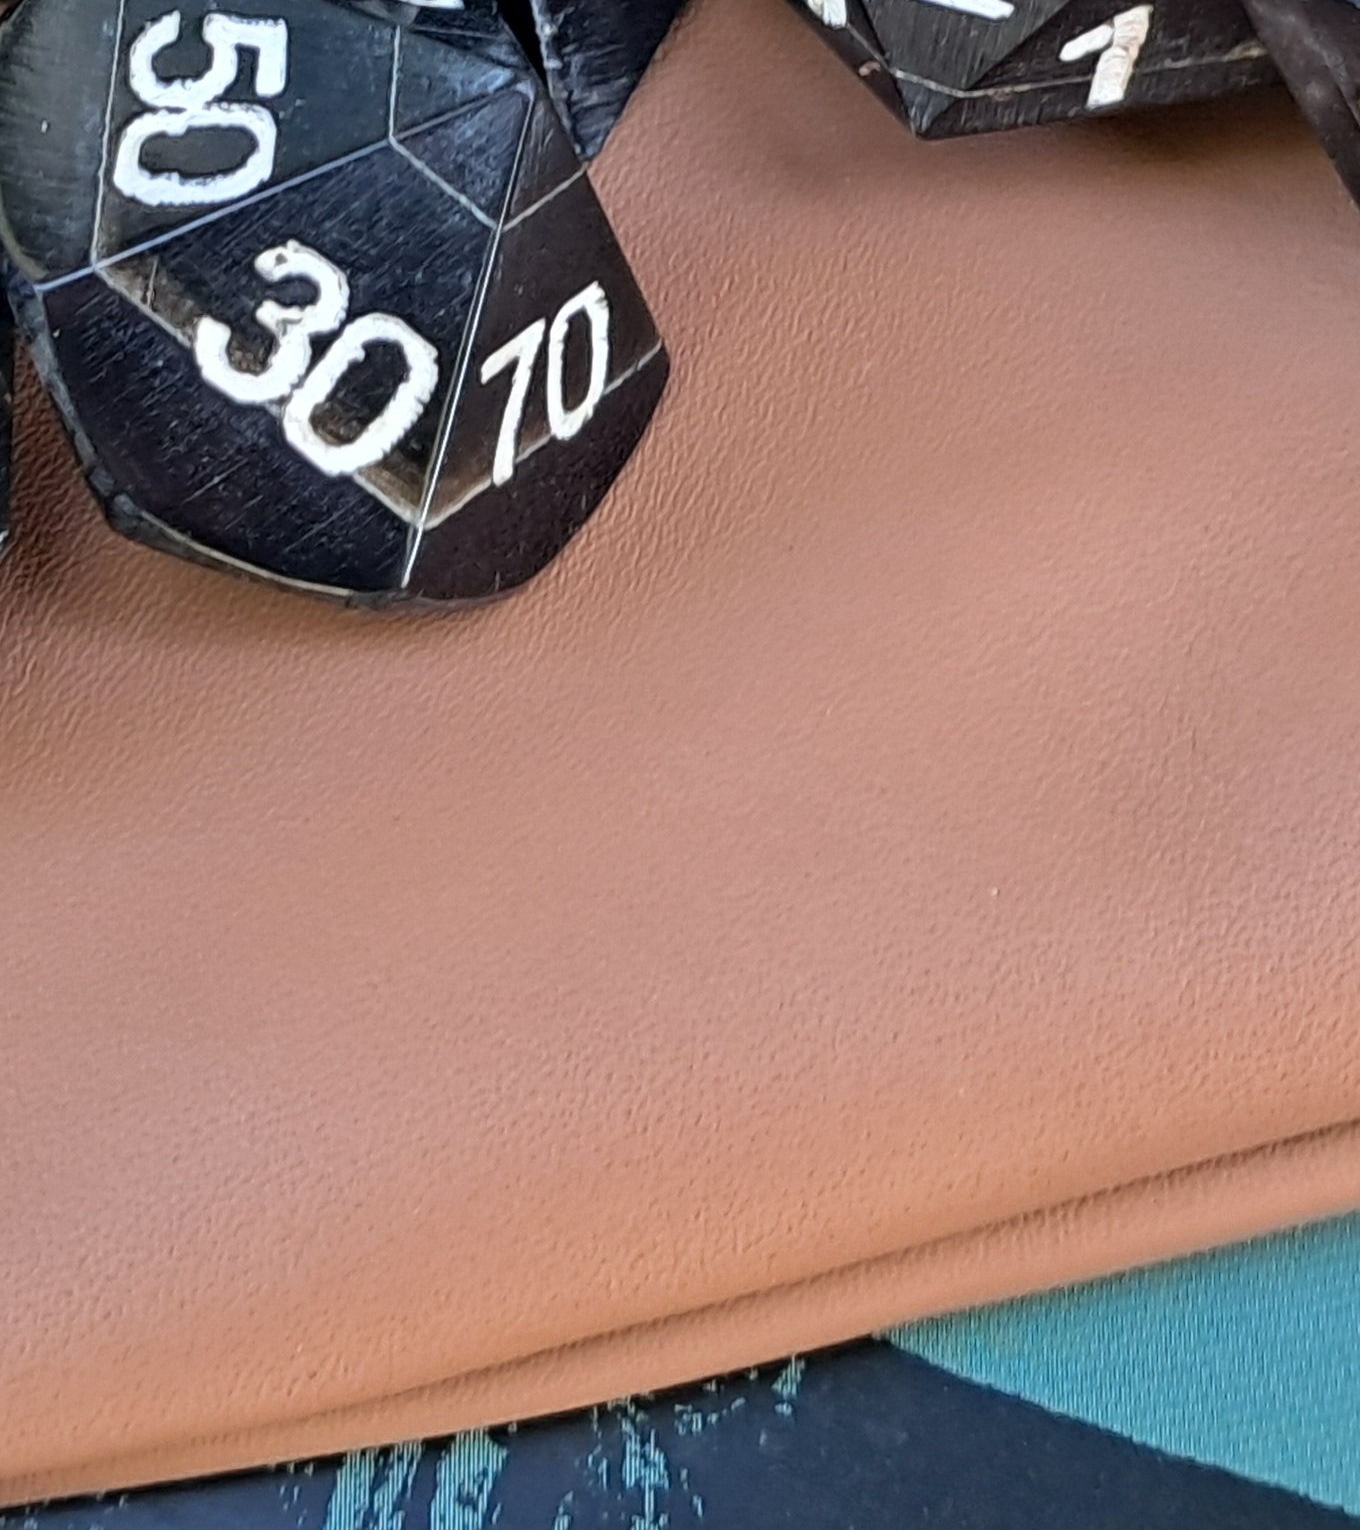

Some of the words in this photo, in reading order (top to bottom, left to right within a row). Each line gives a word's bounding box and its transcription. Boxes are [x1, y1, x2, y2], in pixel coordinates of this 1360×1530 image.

[112, 10, 288, 207] 50
[1059, 3, 1154, 110] 1
[193, 238, 439, 477] 30
[480, 281, 611, 485] 70
